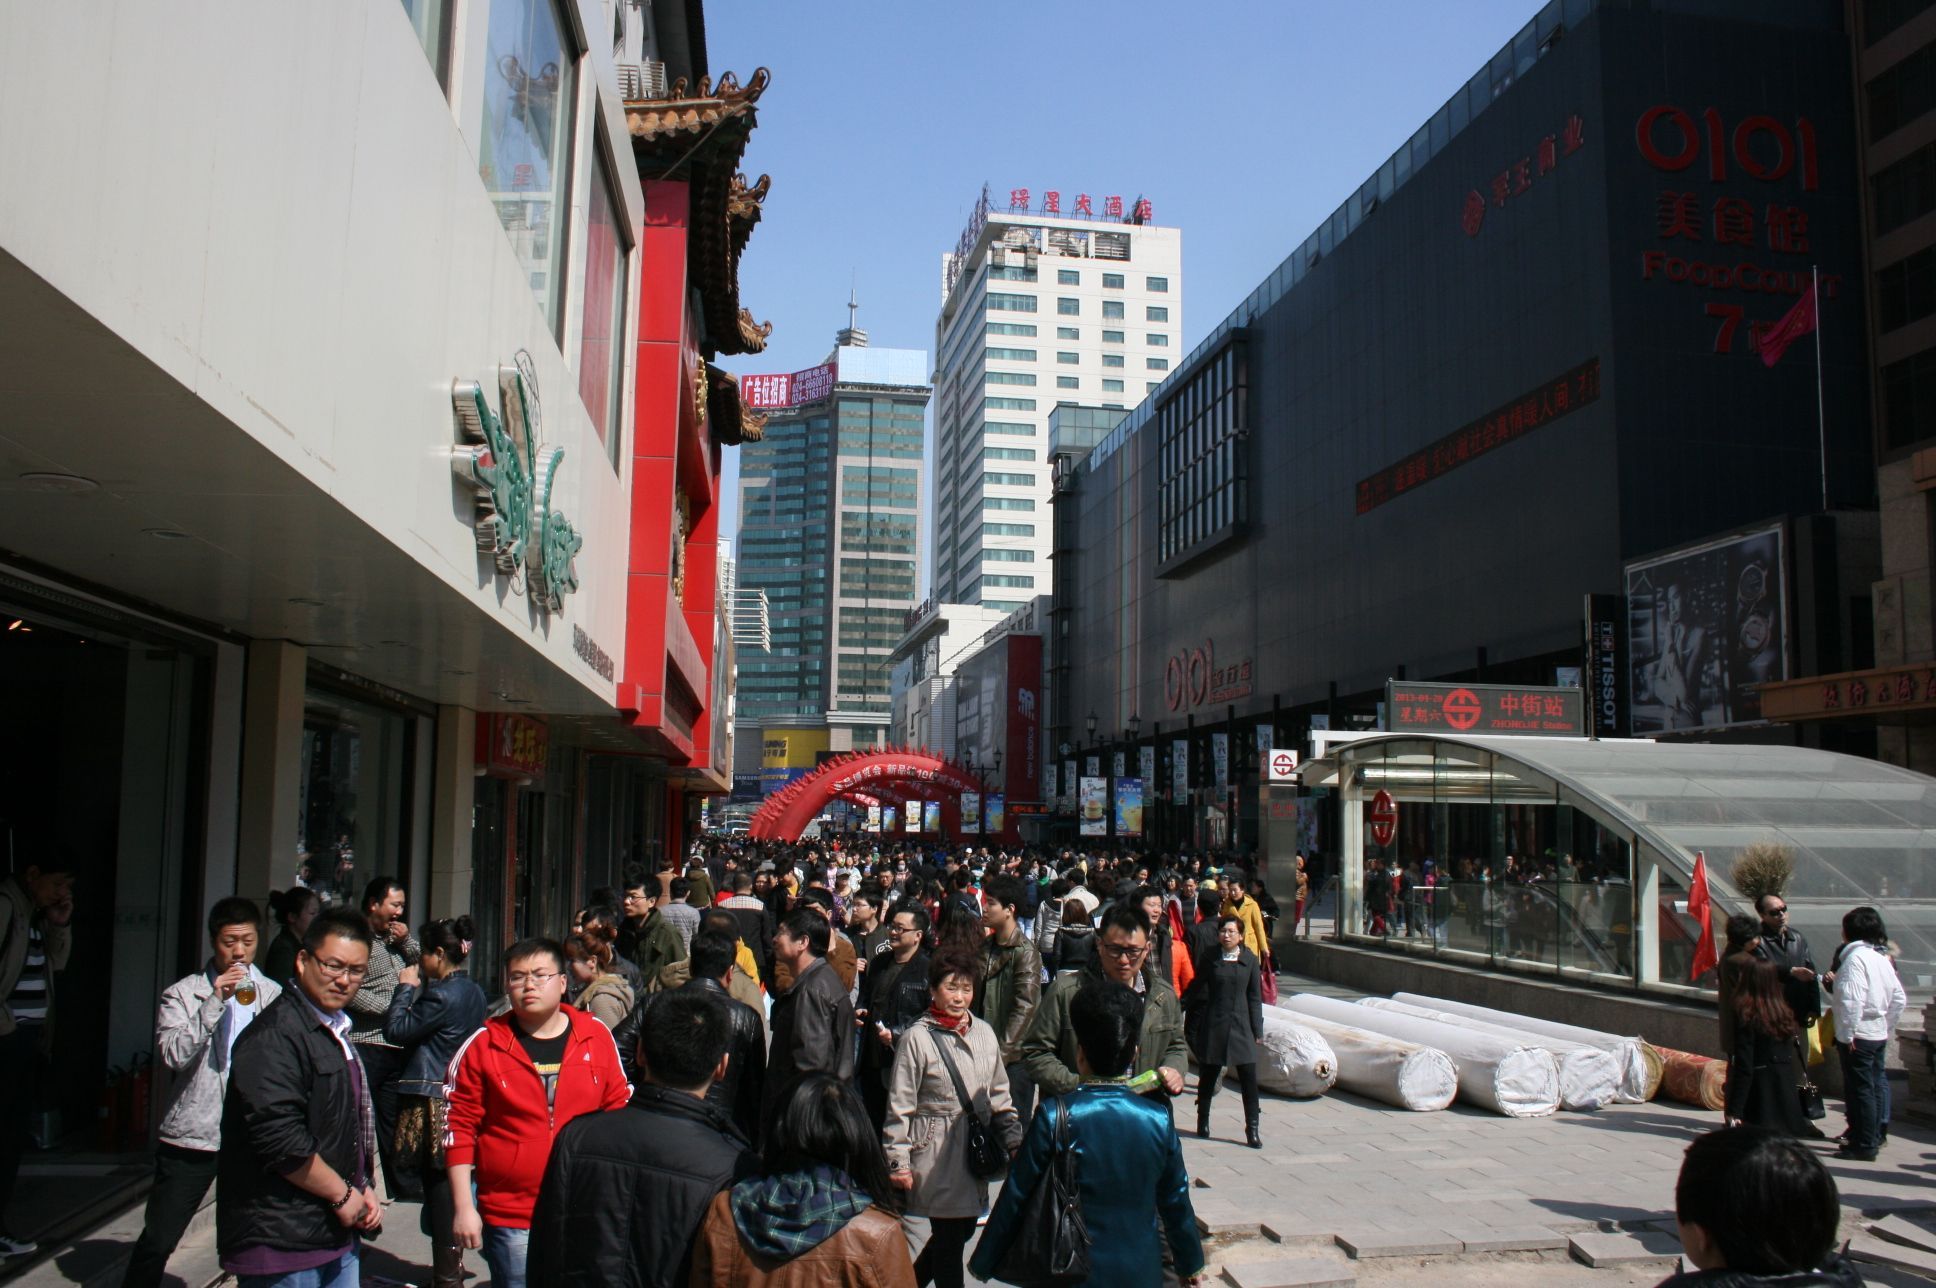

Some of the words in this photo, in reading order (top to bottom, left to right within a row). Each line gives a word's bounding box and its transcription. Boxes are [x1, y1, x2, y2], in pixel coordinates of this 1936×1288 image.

[1656, 191, 1810, 256] 美食馆
[745, 376, 788, 406] 广告位招商
[1500, 692, 1565, 718] 中街站
[1602, 652, 1616, 730] TISSOT
[1399, 706, 1441, 724] 星期六
[1491, 719, 1541, 729] ZHONGJIE
